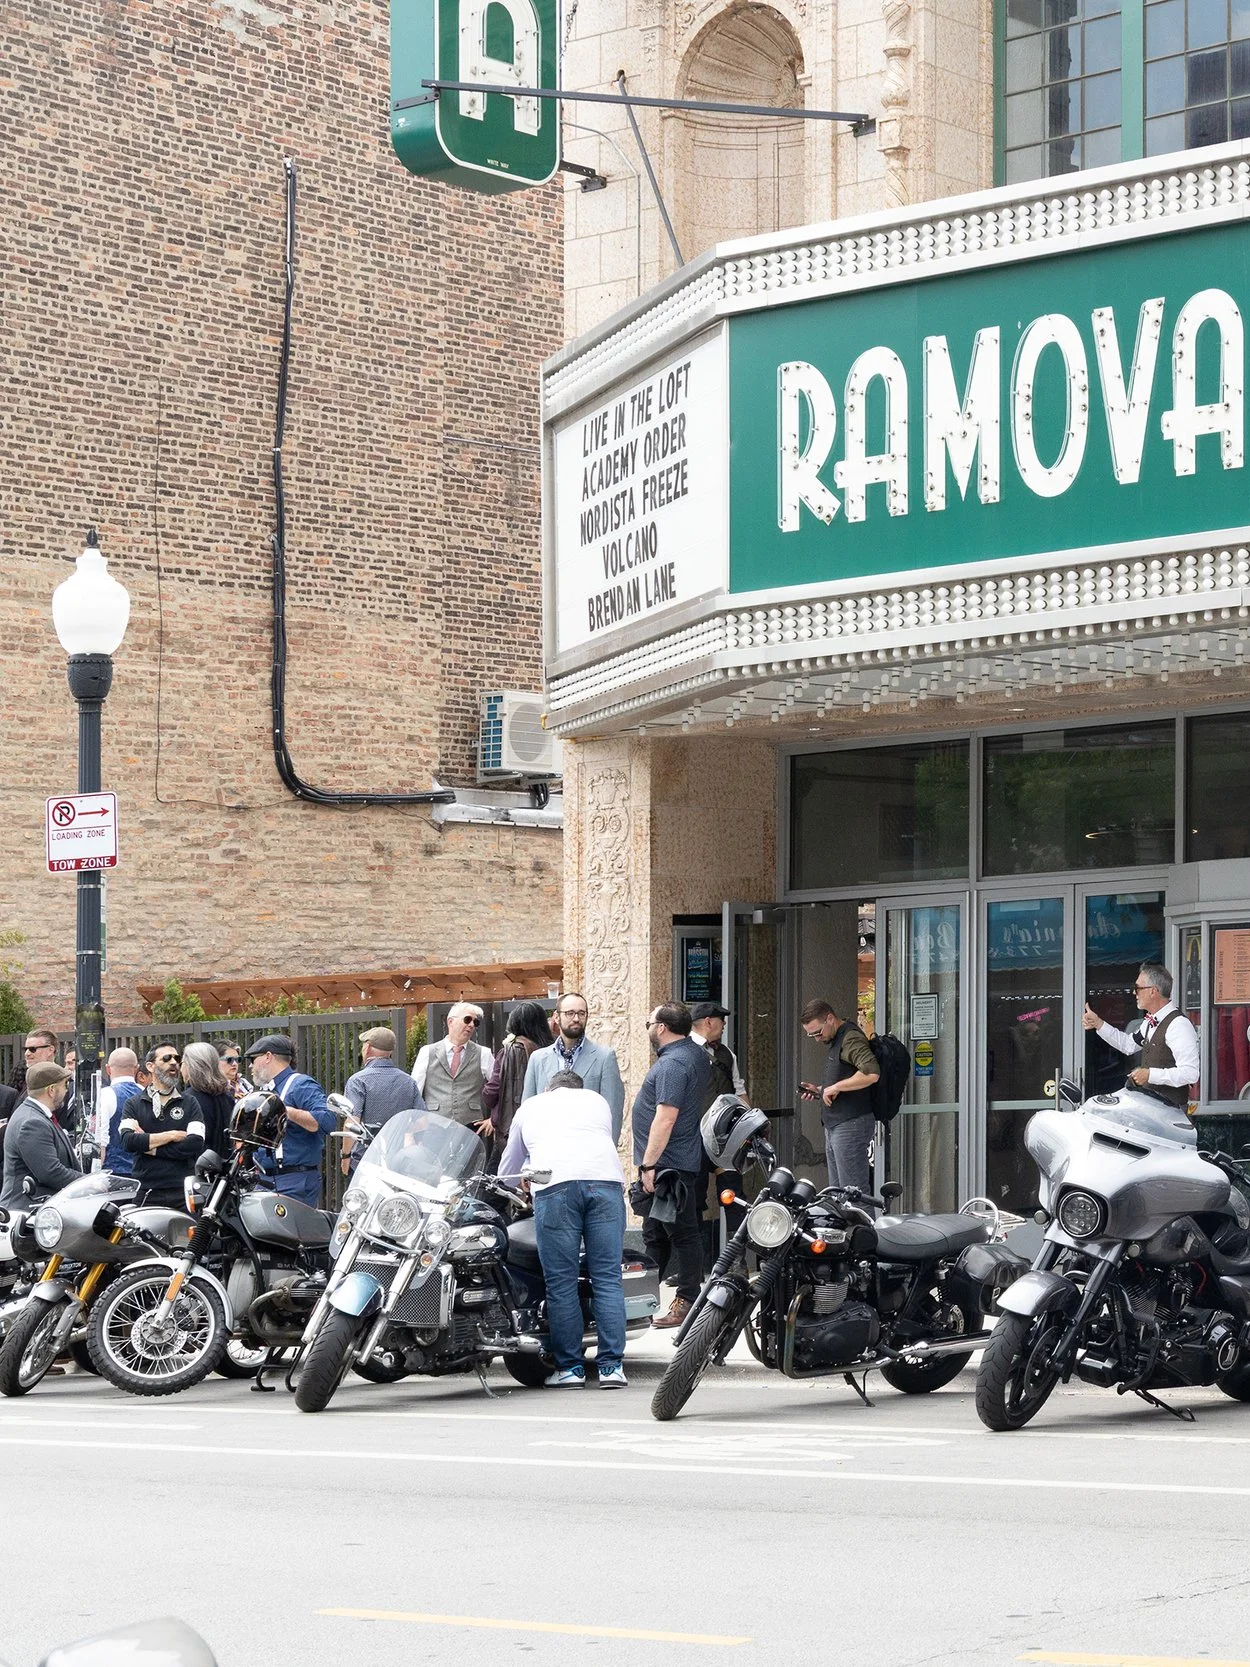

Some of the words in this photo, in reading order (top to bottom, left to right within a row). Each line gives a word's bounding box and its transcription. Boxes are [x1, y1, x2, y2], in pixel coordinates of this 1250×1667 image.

[583, 411, 609, 458] LIVE
[614, 401, 625, 441] IN
[630, 385, 653, 429] THE
[658, 361, 692, 414] LOFT
[776, 288, 1245, 533] RAMOVA
[582, 438, 639, 502] ACADEMY
[644, 412, 687, 467] ORDER
[580, 490, 636, 547] NORDISTA
[642, 458, 689, 516] FREEZE
[602, 521, 658, 579] VOLCANO
[588, 576, 641, 633] BRENDAN
[645, 562, 677, 609] LANE
[51, 831, 83, 841] LOADING
[87, 829, 106, 838] ZONE
[52, 860, 76, 871] TOW
[80, 857, 112, 869] ZONE
